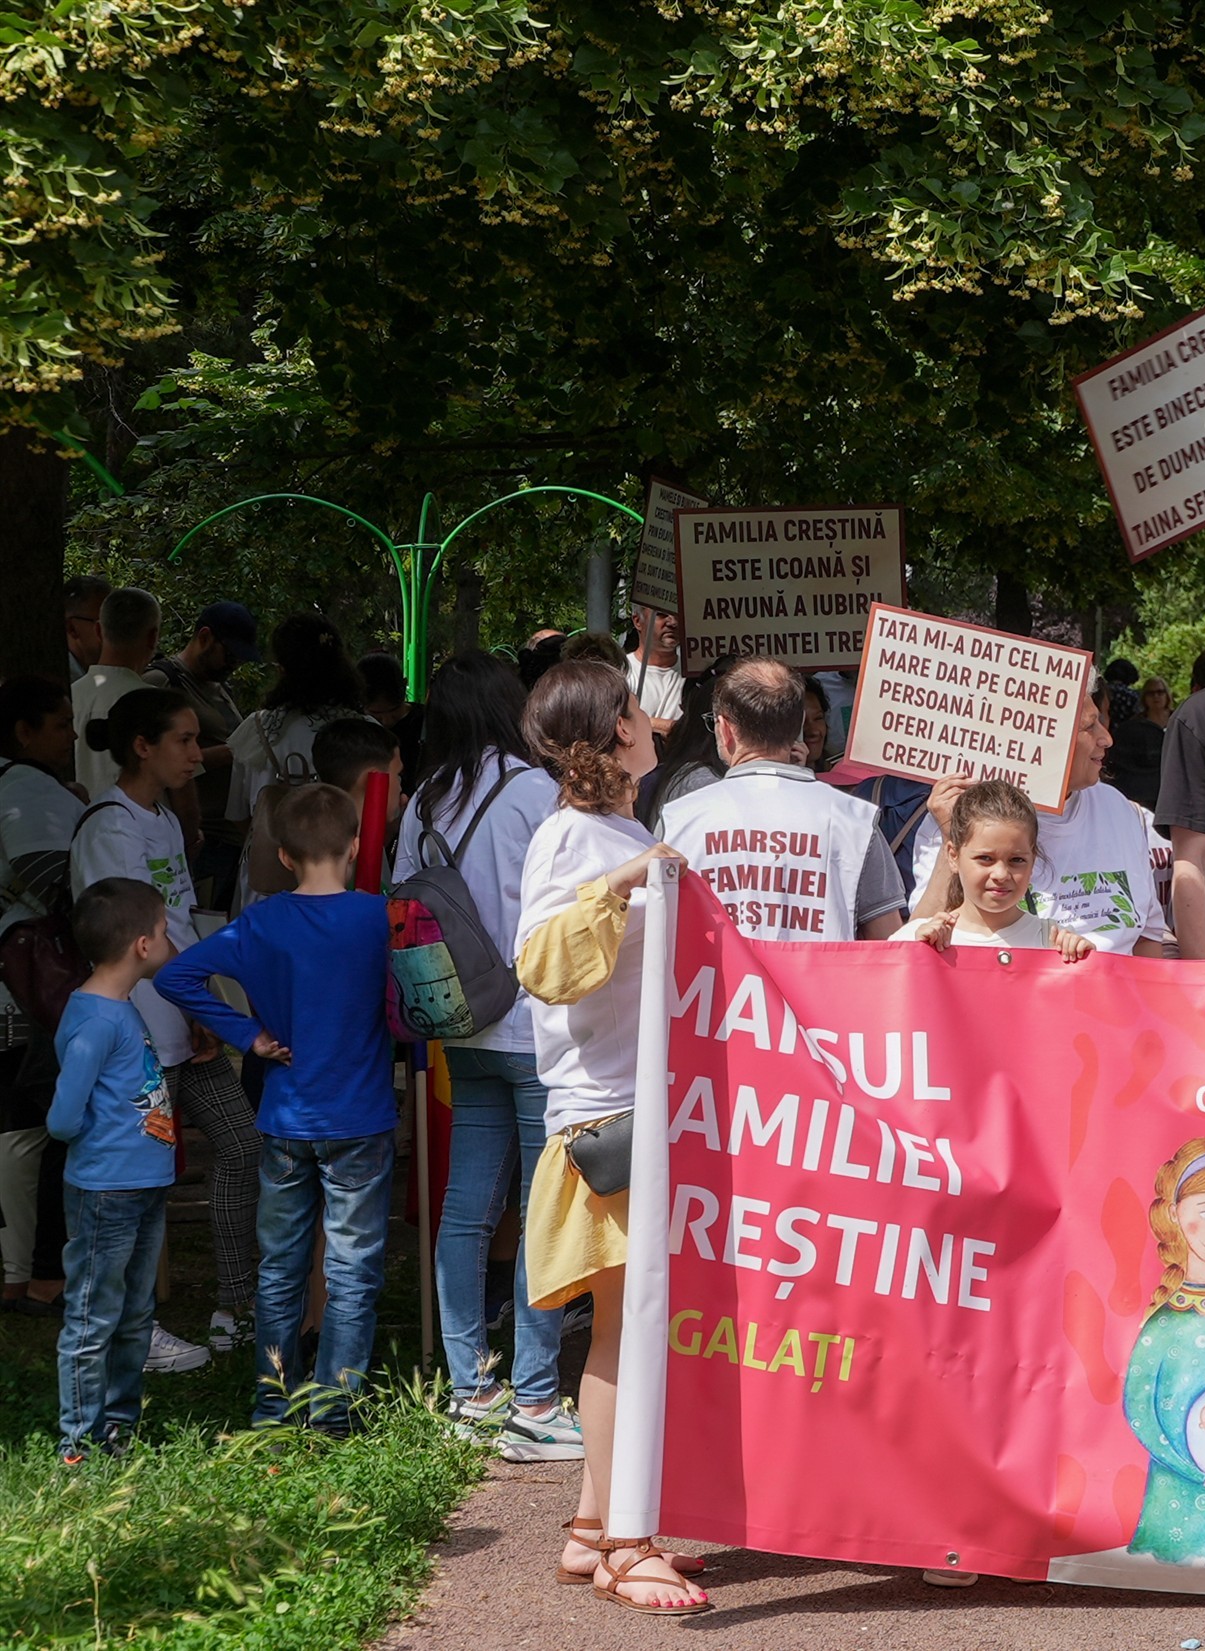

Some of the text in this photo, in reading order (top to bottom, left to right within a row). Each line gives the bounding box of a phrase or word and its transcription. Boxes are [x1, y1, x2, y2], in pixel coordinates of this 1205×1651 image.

[1108, 350, 1178, 401] FAMILIA
[1110, 415, 1154, 452] ESTE
[1132, 465, 1158, 494] DE
[694, 512, 886, 548] FAMILIA CREȘTINĂ
[1131, 506, 1183, 546] TAINA
[712, 551, 870, 585] ESTE ICOANĂ ȘI
[703, 590, 788, 620] ARVUNĂ
[794, 595, 807, 616] A
[687, 631, 866, 658] PREASFINTEI TRE
[878, 617, 1081, 681] TATA MI-A DAT CEL MAI
[879, 648, 1068, 709] MARE DAR PE CARE O
[879, 679, 1057, 738] PERSOANĂ ÎL POATE
[882, 711, 1042, 766] OFERI ALTEIA: EL A
[882, 742, 951, 774] CREZUT
[956, 753, 975, 778] ÎN
[705, 829, 821, 861] MARȘUL
[701, 864, 826, 898] FAMILIEI
[723, 901, 824, 932] RȘTINE
[668, 1072, 962, 1195] AMILIEI
[669, 1184, 996, 1311] REȘTINE
[669, 1309, 855, 1393] GALAȚI
